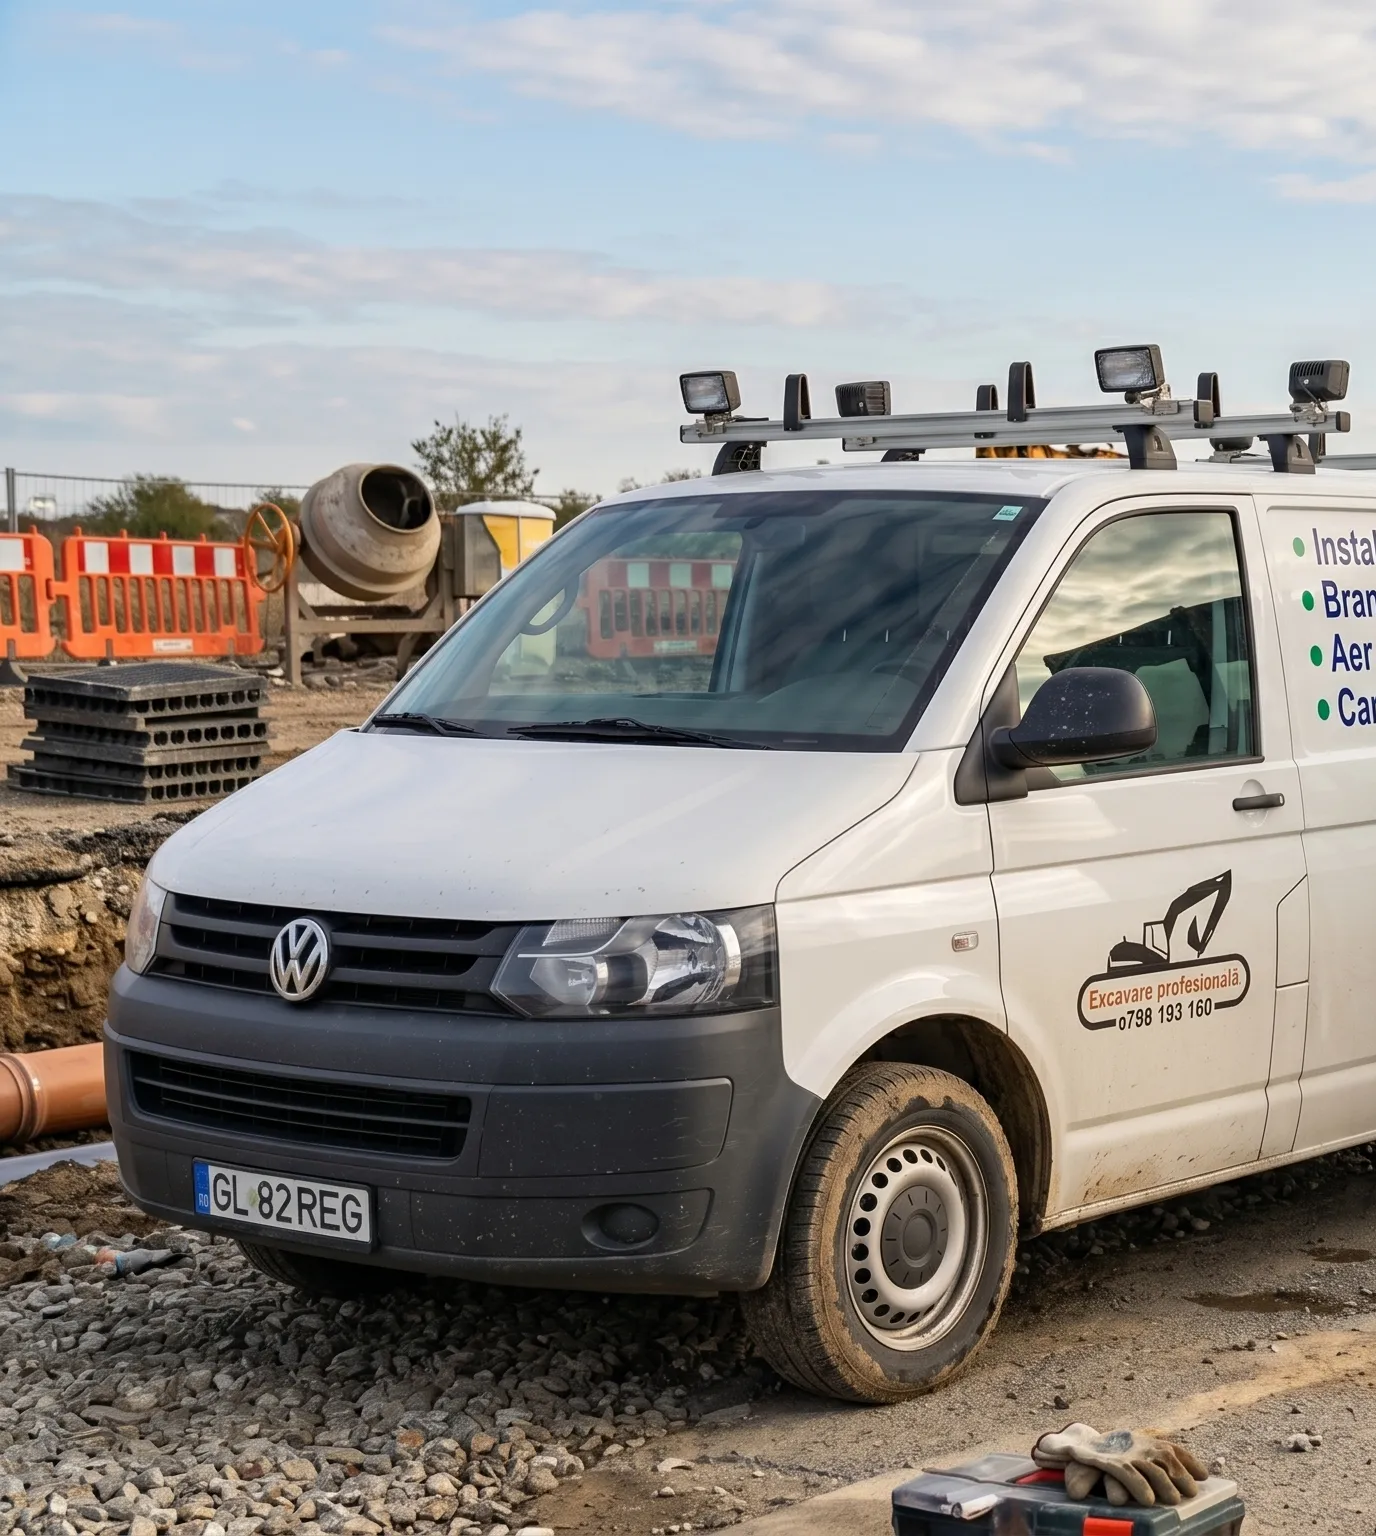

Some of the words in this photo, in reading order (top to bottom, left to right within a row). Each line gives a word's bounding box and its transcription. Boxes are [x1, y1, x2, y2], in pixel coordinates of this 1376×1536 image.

[1332, 633, 1372, 672] Aer
[1089, 986, 1153, 1010] Excavare
[1158, 1003, 1182, 1024] 193
[1188, 998, 1212, 1019] 160
[213, 1172, 248, 1217] GL
